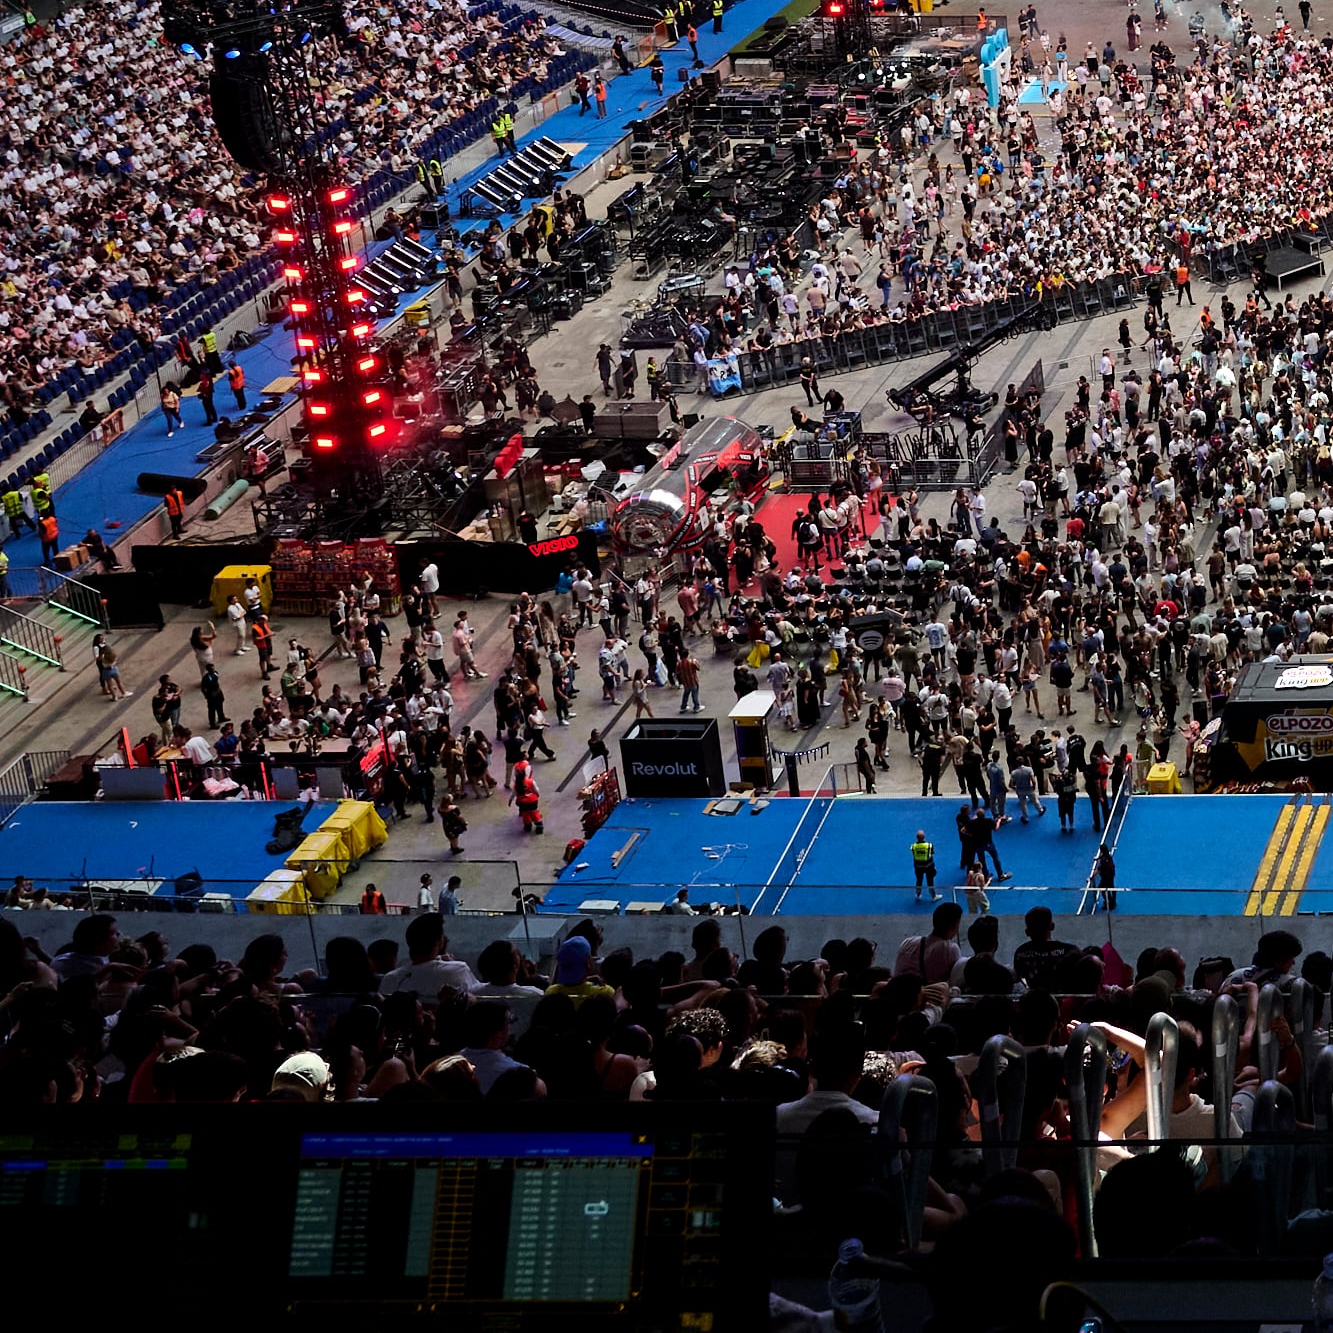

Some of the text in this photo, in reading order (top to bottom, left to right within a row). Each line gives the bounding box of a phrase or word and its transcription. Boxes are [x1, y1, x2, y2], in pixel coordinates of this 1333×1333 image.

[528, 535, 579, 557] VICIO
[1265, 737, 1313, 761] king
[632, 761, 698, 776] Revolut
